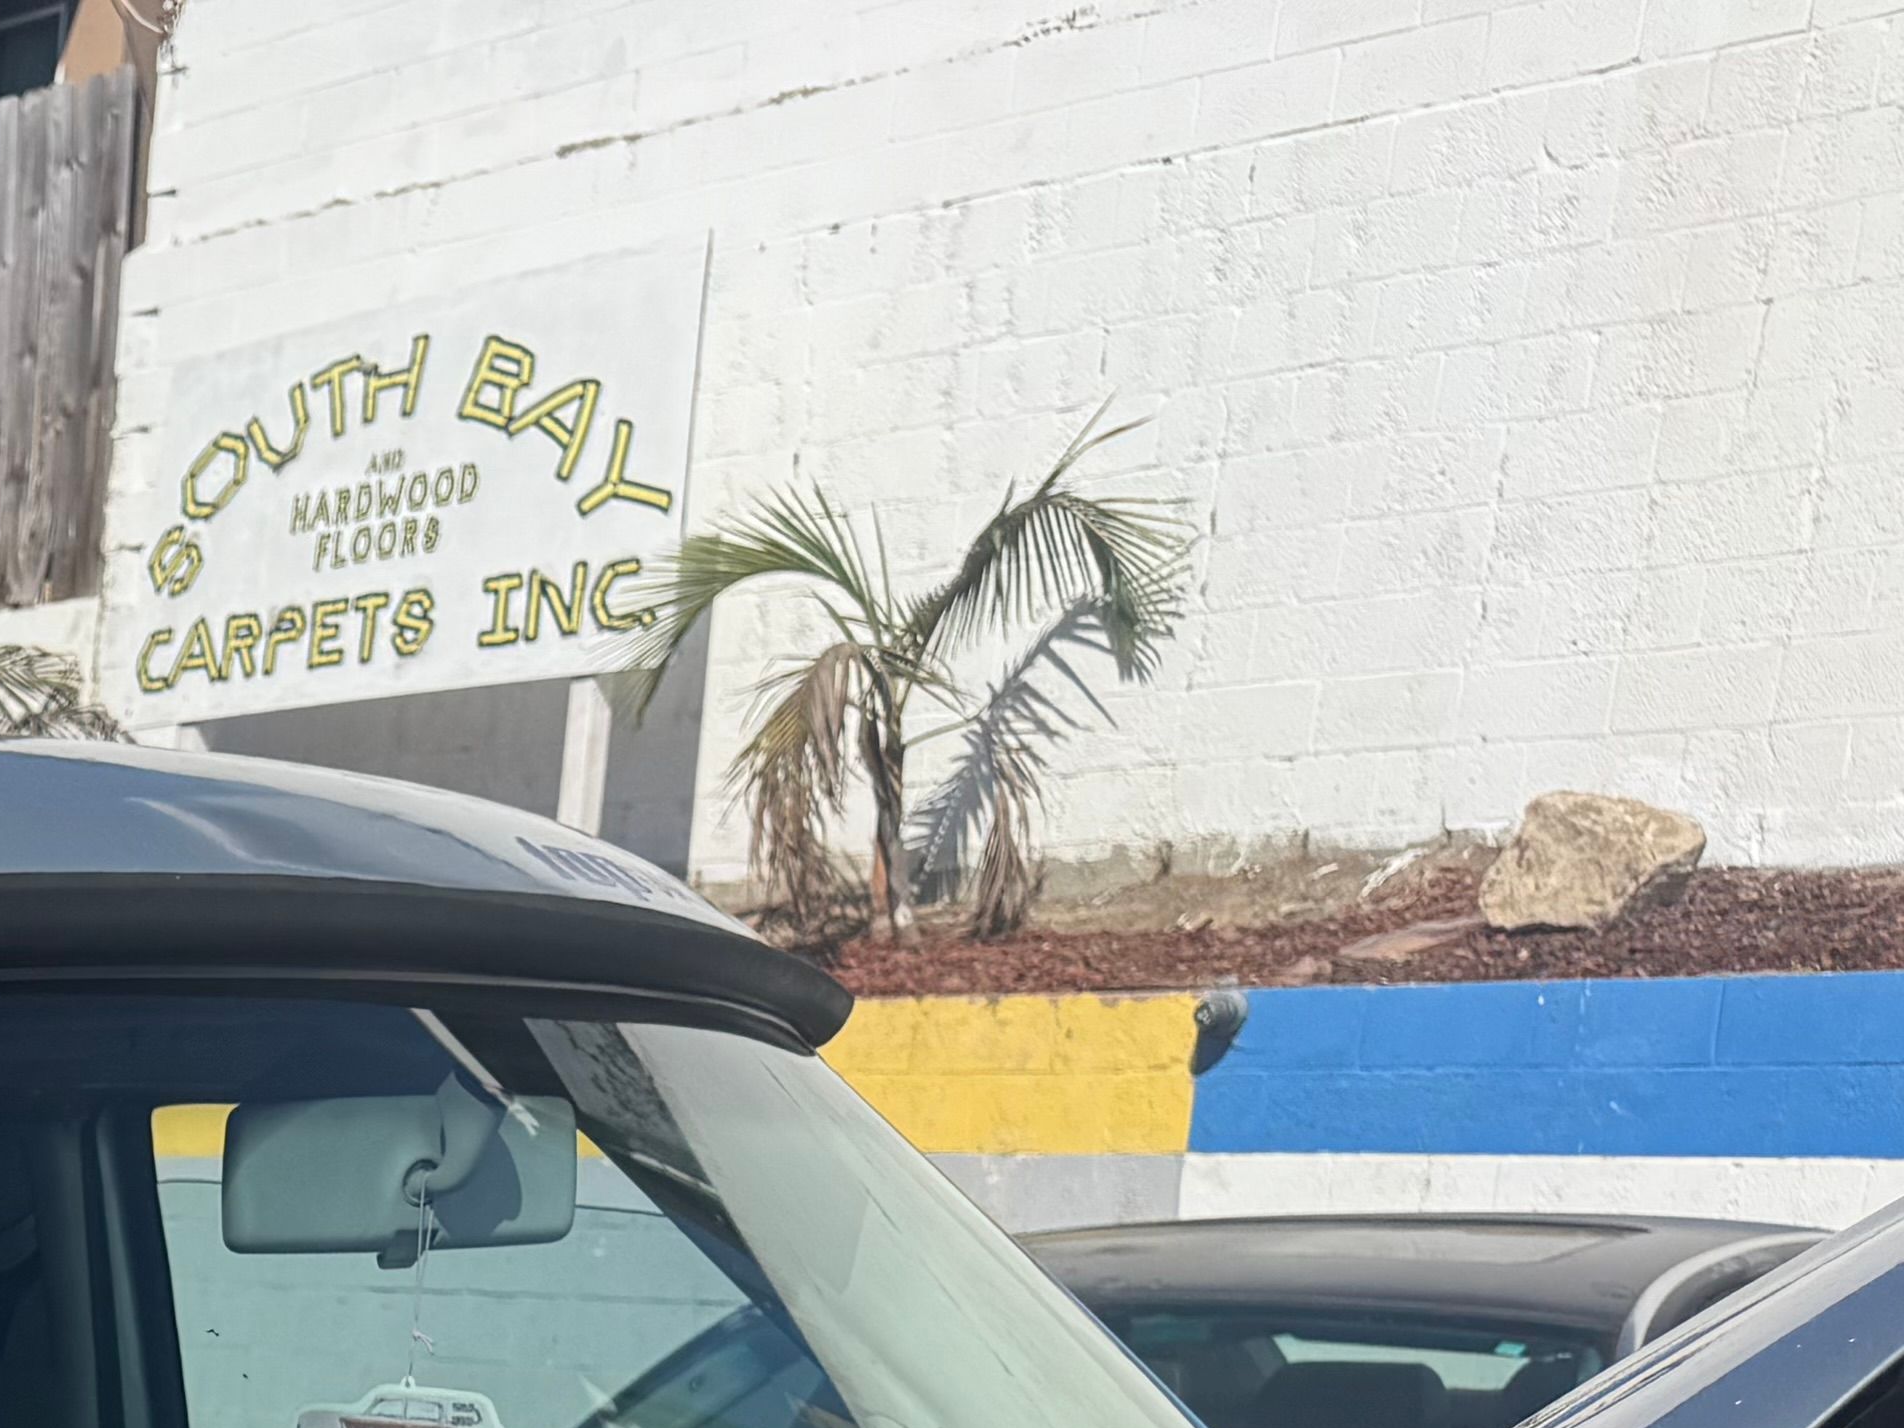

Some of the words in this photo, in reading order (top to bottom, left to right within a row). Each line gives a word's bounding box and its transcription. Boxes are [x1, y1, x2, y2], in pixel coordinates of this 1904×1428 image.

[147, 332, 430, 597] SOUTH
[458, 334, 673, 515] BAY
[291, 462, 480, 534] HARDWOOD
[313, 517, 441, 571] FLOORS
[137, 589, 435, 693] CARPETS
